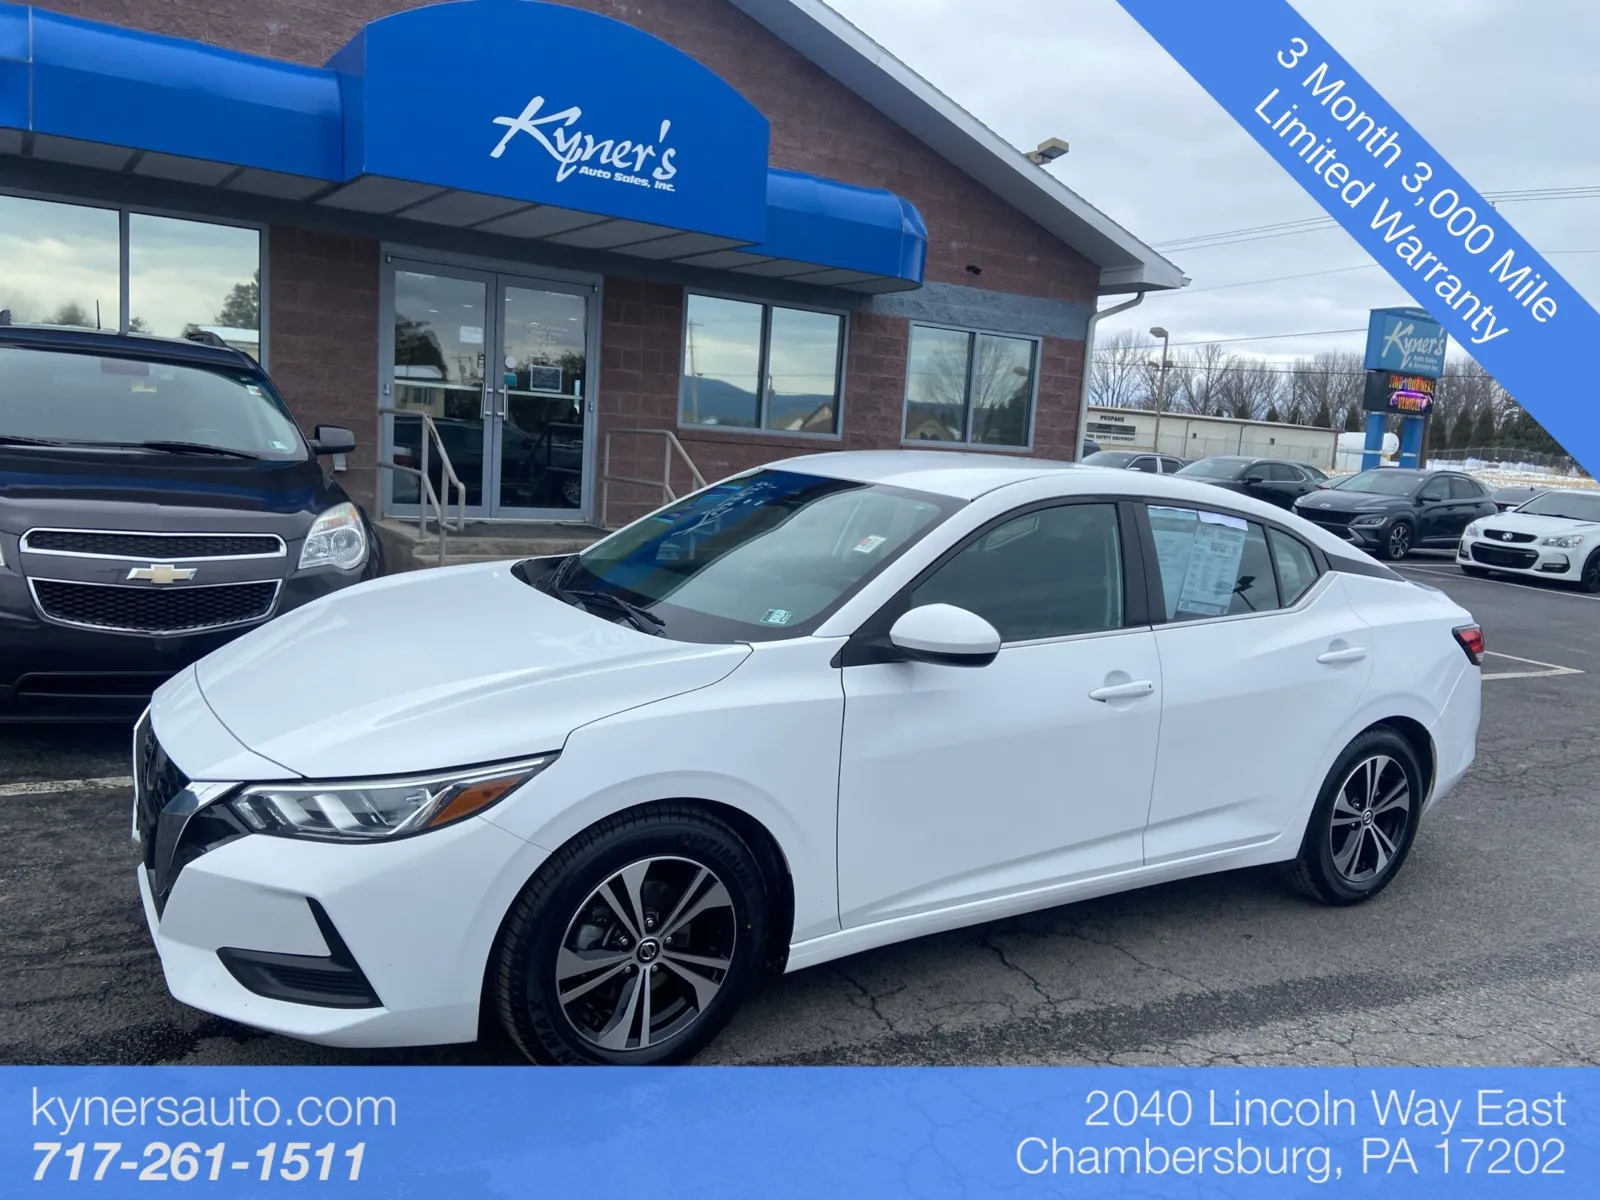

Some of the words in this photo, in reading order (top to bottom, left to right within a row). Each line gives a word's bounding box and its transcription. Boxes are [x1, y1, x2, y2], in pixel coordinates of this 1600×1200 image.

[489, 95, 678, 183] Kyner's
[578, 165, 611, 179] Auto
[613, 172, 651, 188] Sales,
[654, 180, 676, 192] Inc.
[1381, 320, 1445, 370] Kyner's
[1100, 414, 1125, 422] PROPANE
